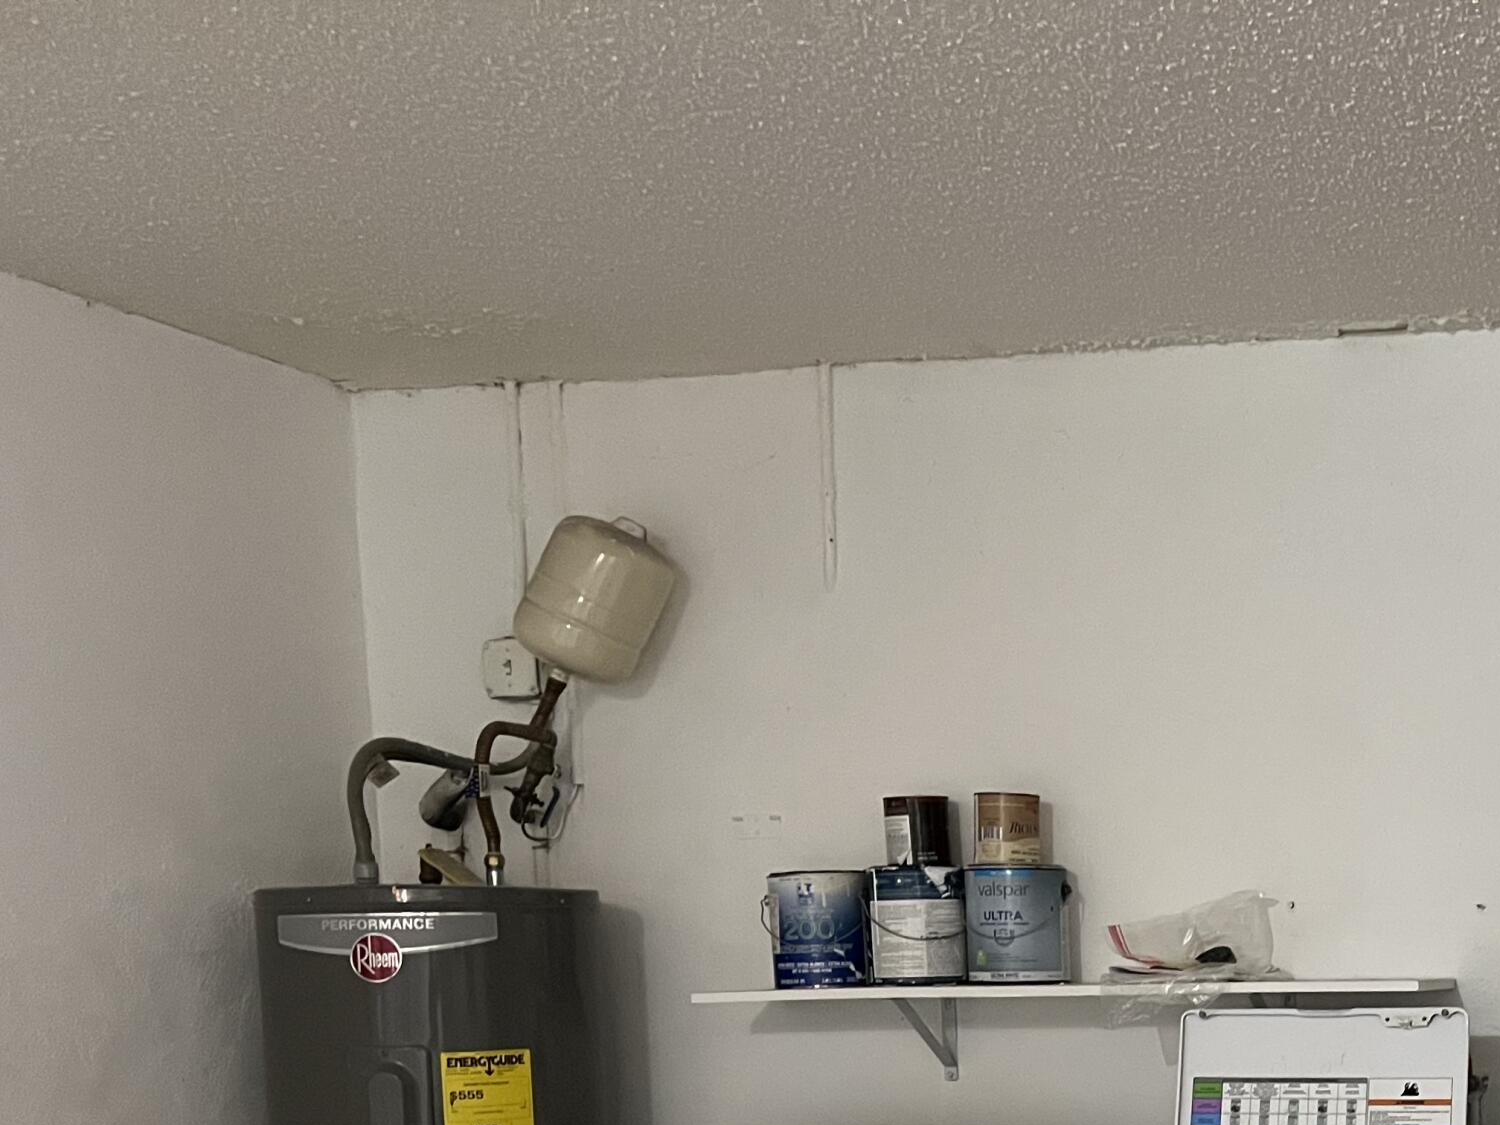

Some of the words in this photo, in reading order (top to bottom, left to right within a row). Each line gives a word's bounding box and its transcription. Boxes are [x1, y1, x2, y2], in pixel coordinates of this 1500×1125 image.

[977, 881, 1031, 900] valspar
[321, 918, 435, 931] PERFORMANCE
[983, 910, 1024, 921] ULTRA
[783, 919, 837, 942] 200
[356, 935, 399, 975] Rheem
